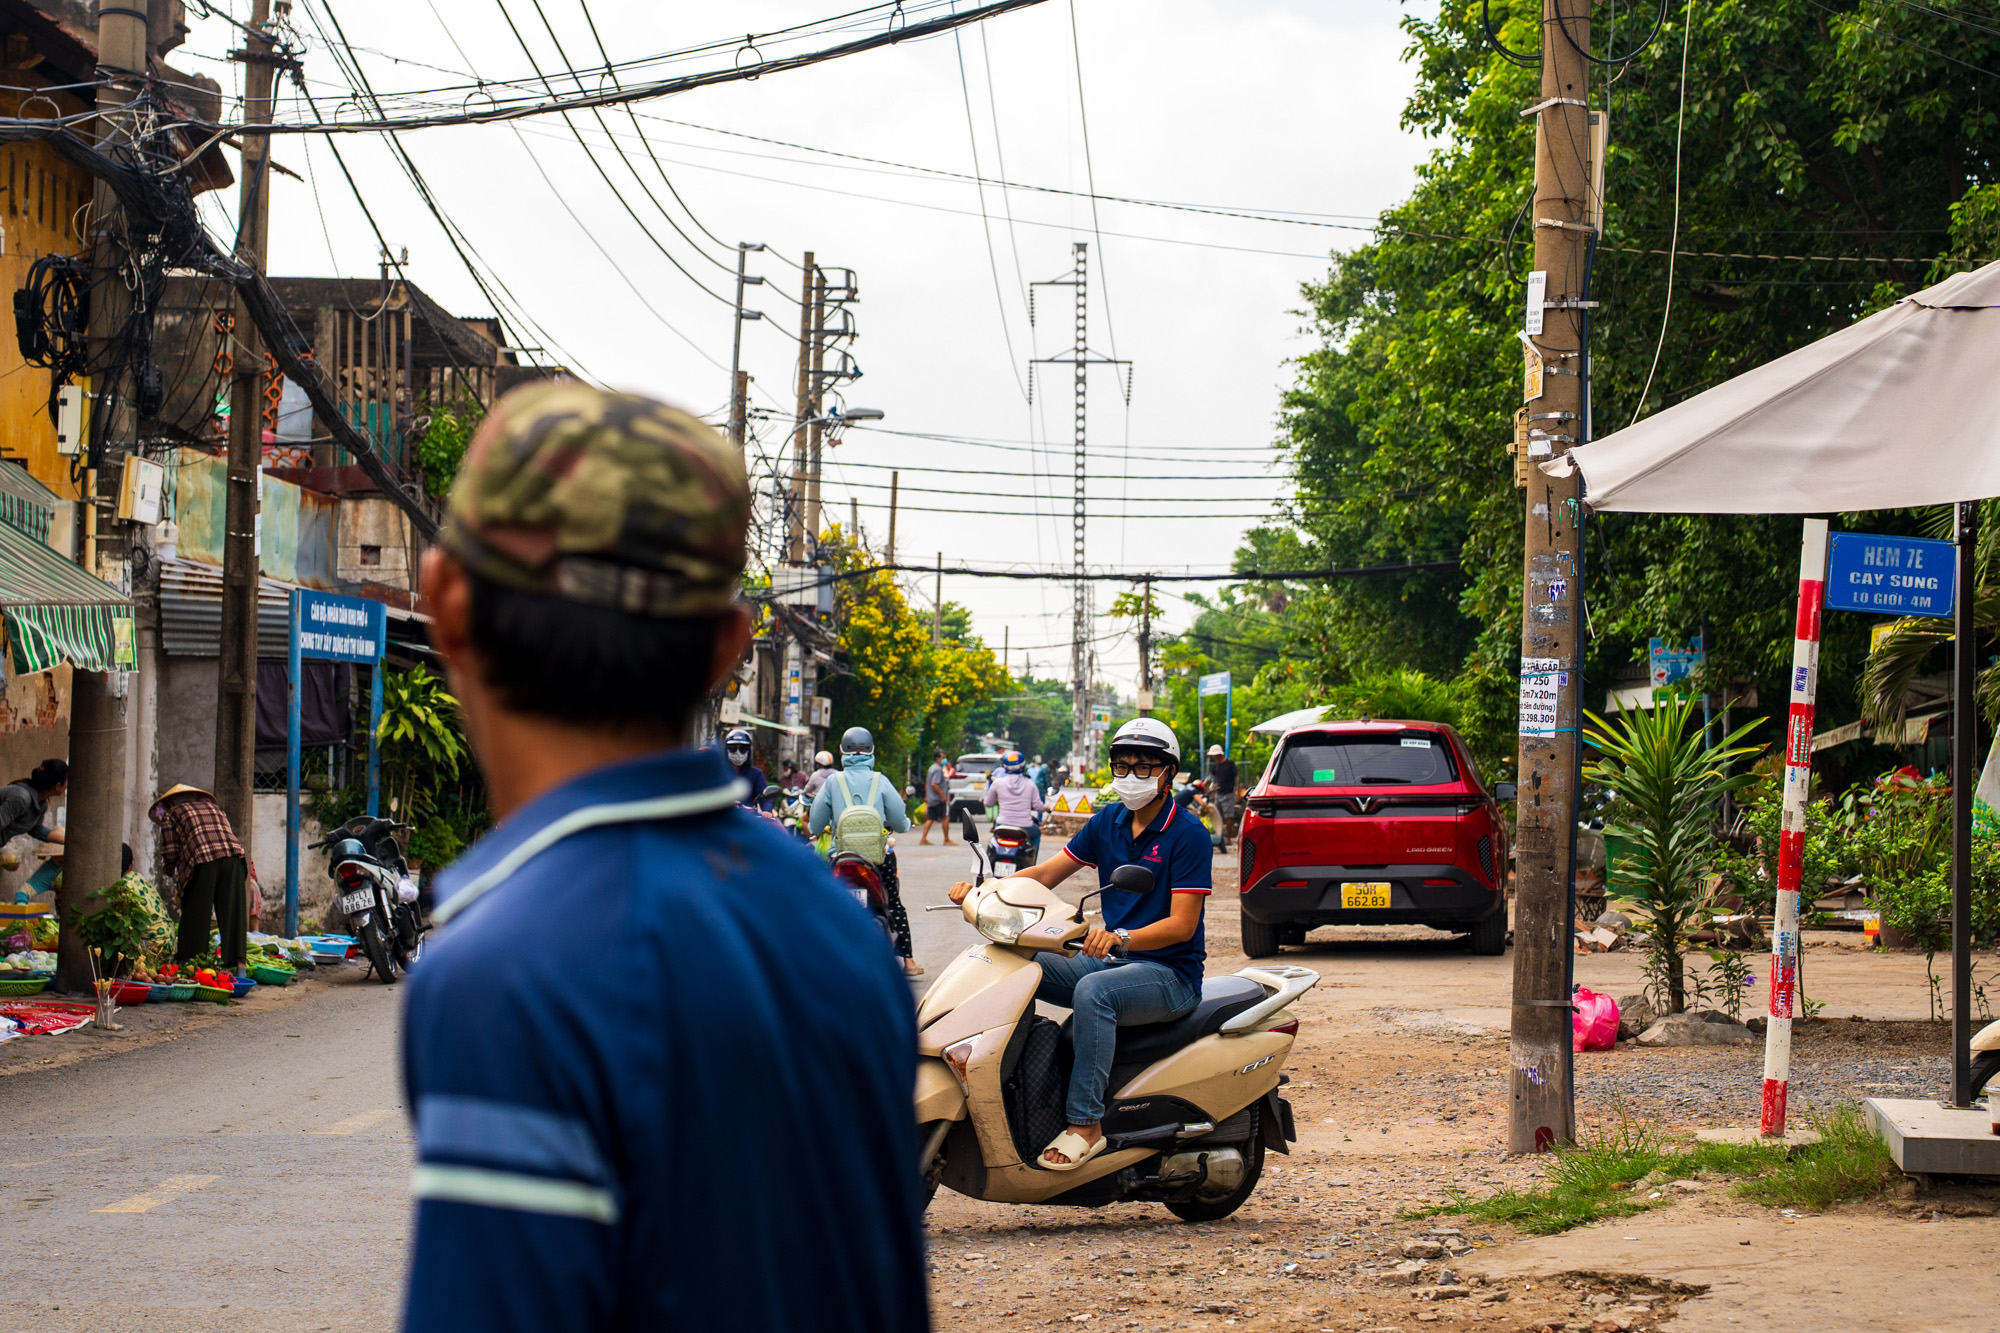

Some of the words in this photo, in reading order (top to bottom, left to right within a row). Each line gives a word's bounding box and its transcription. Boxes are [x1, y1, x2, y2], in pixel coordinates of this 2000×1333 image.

[1907, 548, 1924, 569] 7E
[1911, 595, 1932, 608] 4M
[1534, 676, 1549, 686] 250
[1347, 896, 1386, 907] 662.83
